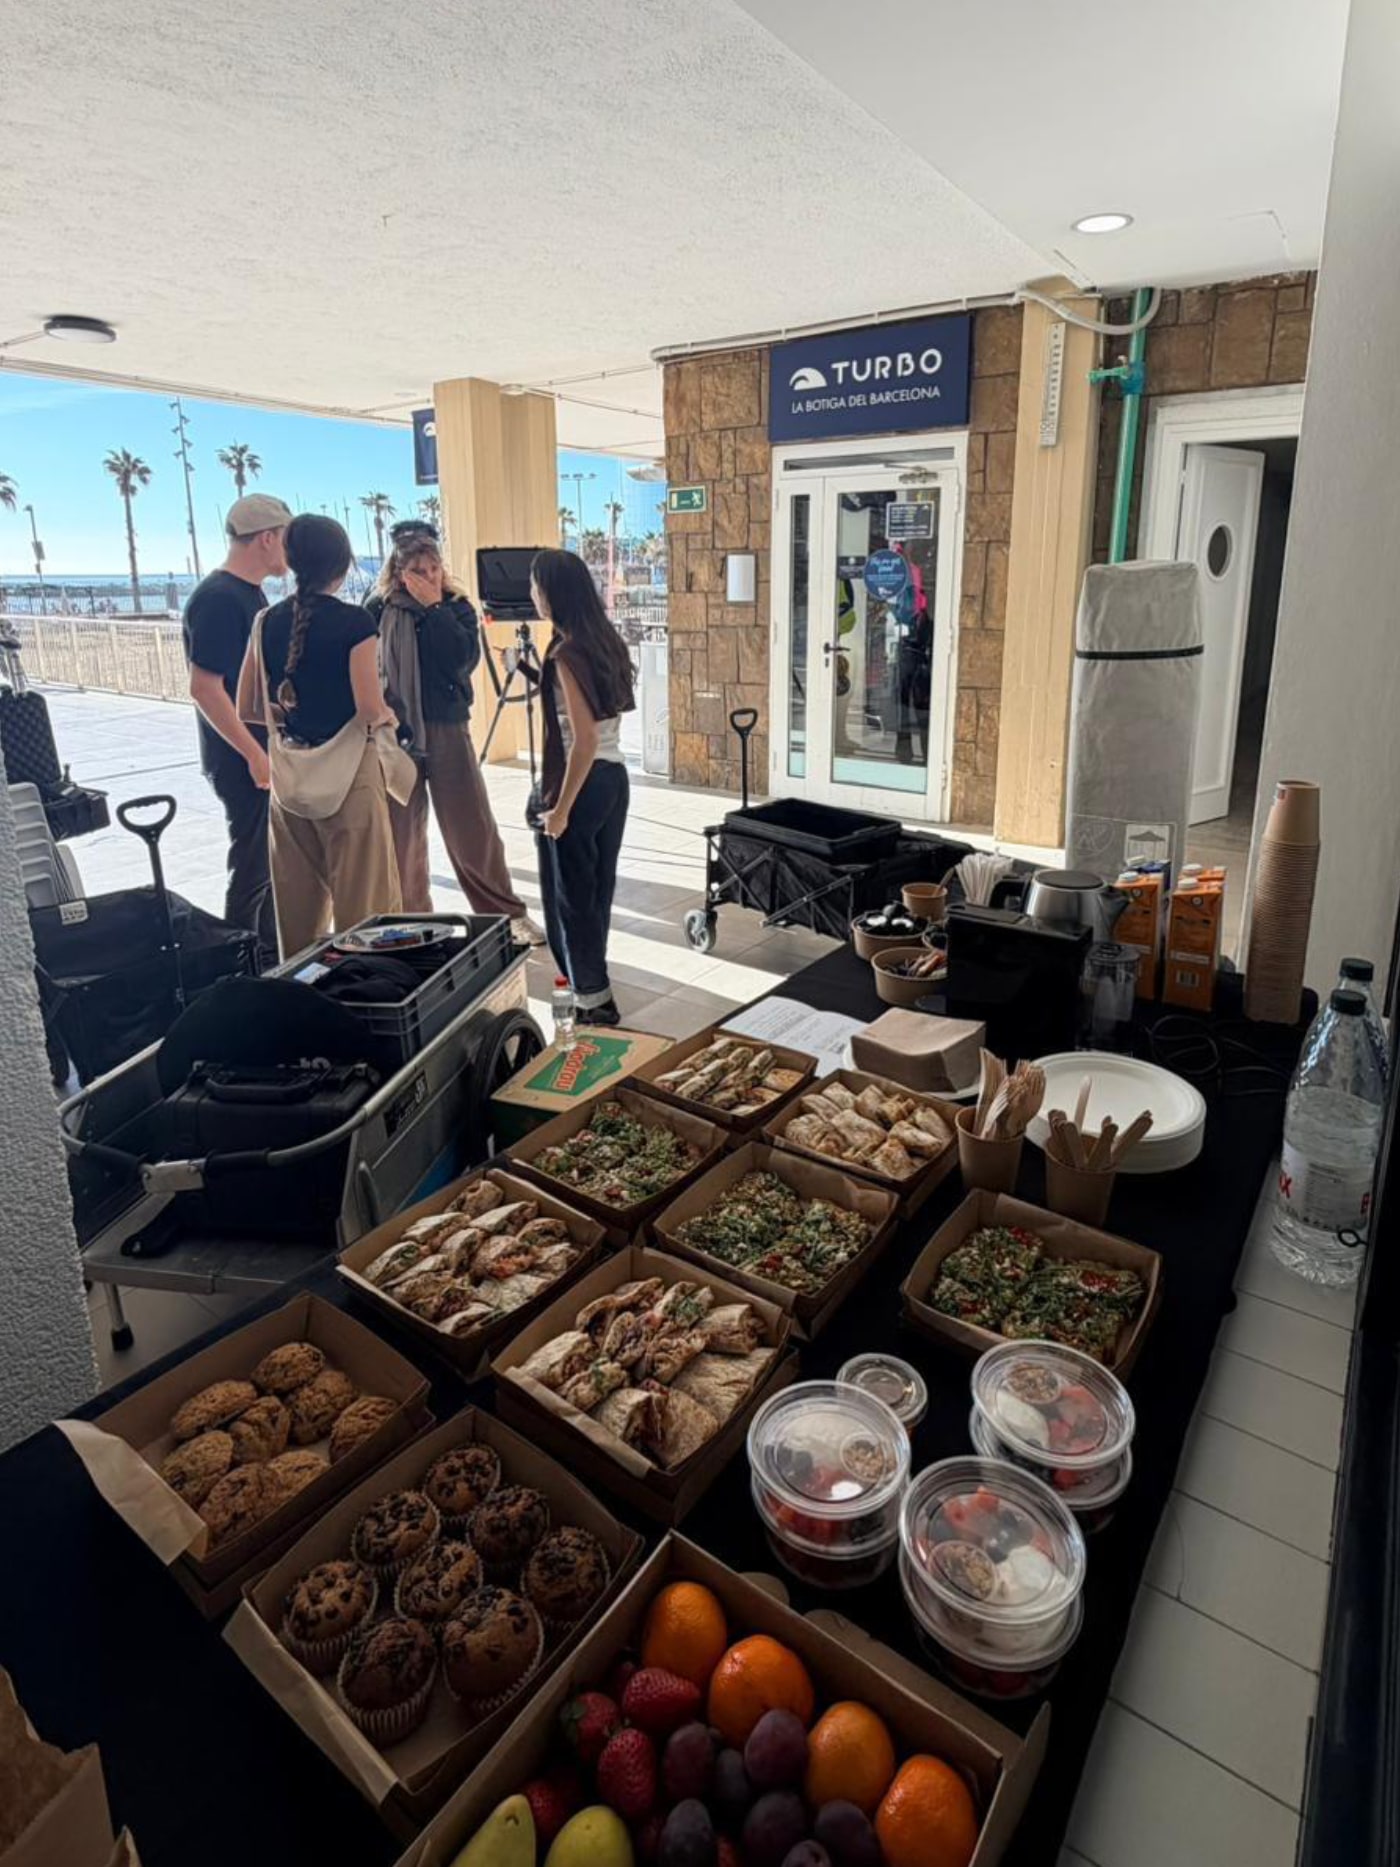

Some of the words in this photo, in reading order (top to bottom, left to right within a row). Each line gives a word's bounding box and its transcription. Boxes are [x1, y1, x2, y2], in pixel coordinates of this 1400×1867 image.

[831, 348, 942, 385] TURBO
[792, 401, 804, 414] LA
[806, 396, 846, 412] BOTIGA
[848, 394, 867, 408] DEL
[870, 386, 940, 405] BARCELONA
